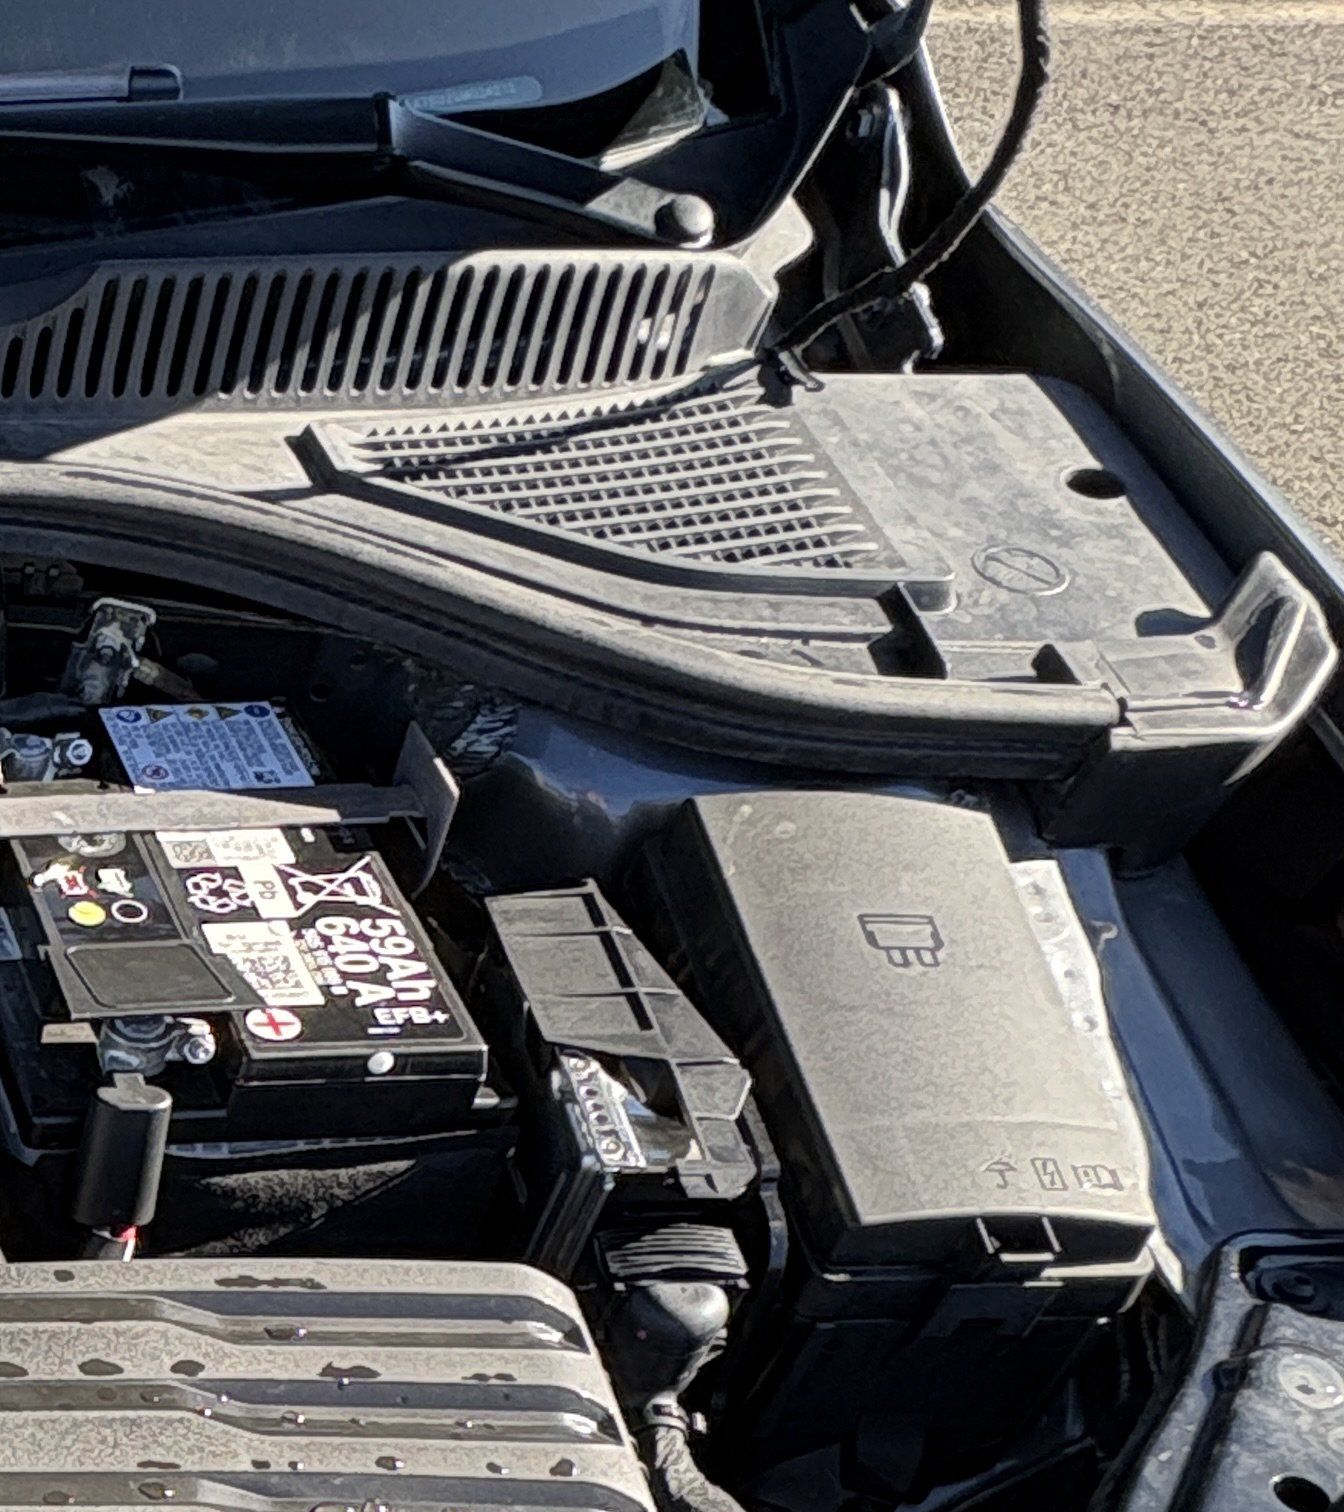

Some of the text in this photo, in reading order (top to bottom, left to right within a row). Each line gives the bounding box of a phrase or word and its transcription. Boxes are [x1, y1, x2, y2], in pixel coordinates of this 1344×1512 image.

[253, 879, 278, 900] Pb
[315, 916, 380, 974] 640
[346, 979, 397, 1007] A
[373, 1005, 451, 1025] EFB+
